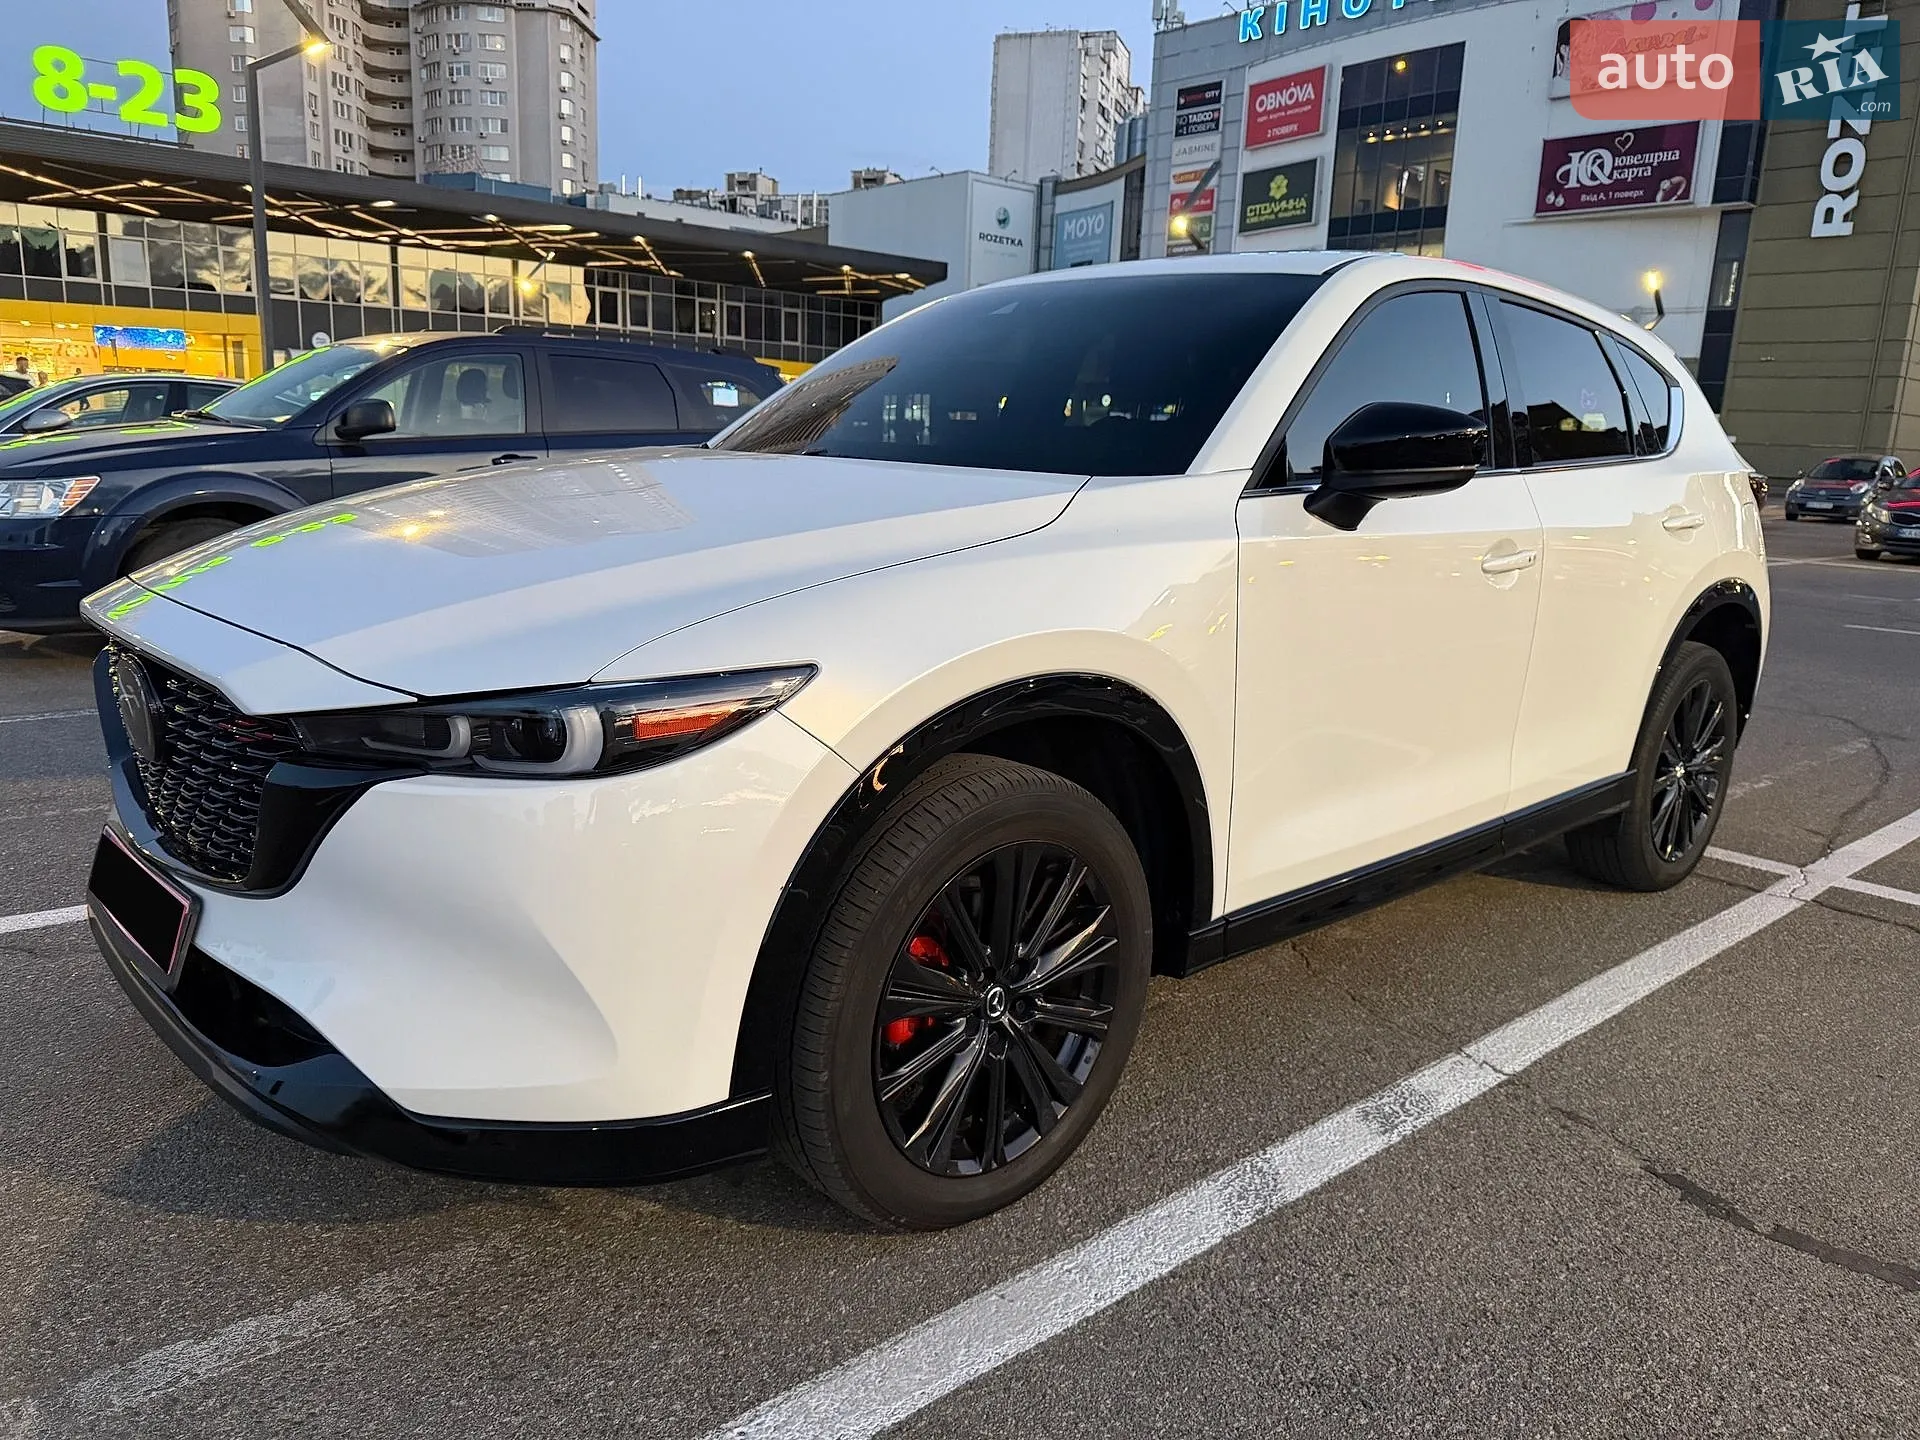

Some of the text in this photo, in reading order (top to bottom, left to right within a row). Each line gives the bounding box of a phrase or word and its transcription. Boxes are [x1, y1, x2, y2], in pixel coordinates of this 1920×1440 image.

[1239, 0, 1405, 43] КІНО
[33, 45, 221, 133] 8-23
[1175, 142, 1216, 157] JASMINE
[1612, 165, 1652, 181] карта
[1614, 190, 1645, 200] поверх
[1064, 213, 1104, 240] MOYO
[979, 232, 1023, 248] ROZETKA
